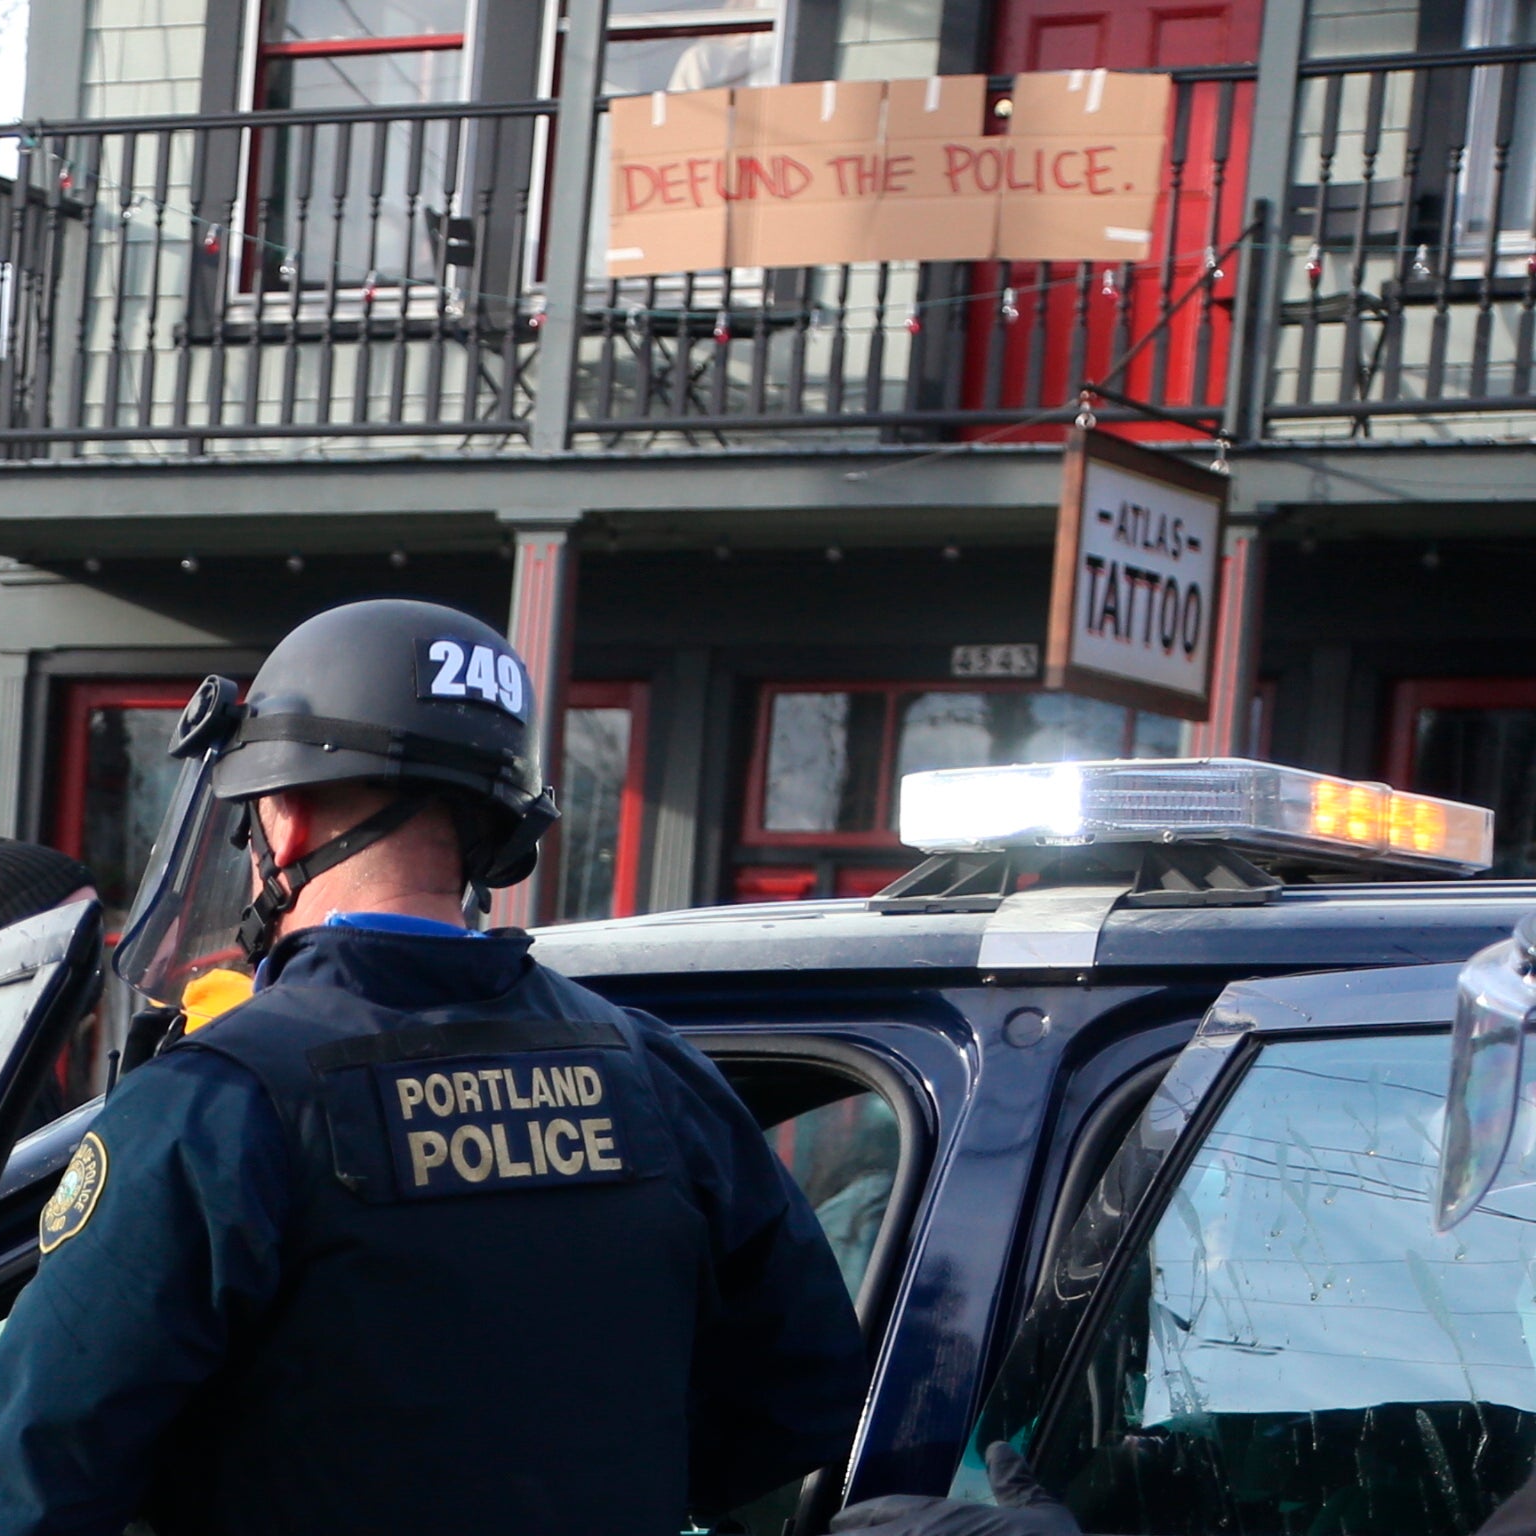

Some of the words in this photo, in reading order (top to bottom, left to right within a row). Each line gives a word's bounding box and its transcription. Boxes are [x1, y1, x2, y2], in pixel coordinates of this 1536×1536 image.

[621, 154, 814, 212] DEFUND
[828, 154, 915, 196] THE
[943, 144, 1136, 196] POLICE.
[1086, 552, 1203, 662] TATTOO
[429, 640, 523, 714] 249
[395, 1065, 603, 1121] PORTLAND
[73, 1160, 97, 1213] POLICE
[407, 1117, 623, 1187] POLICE
